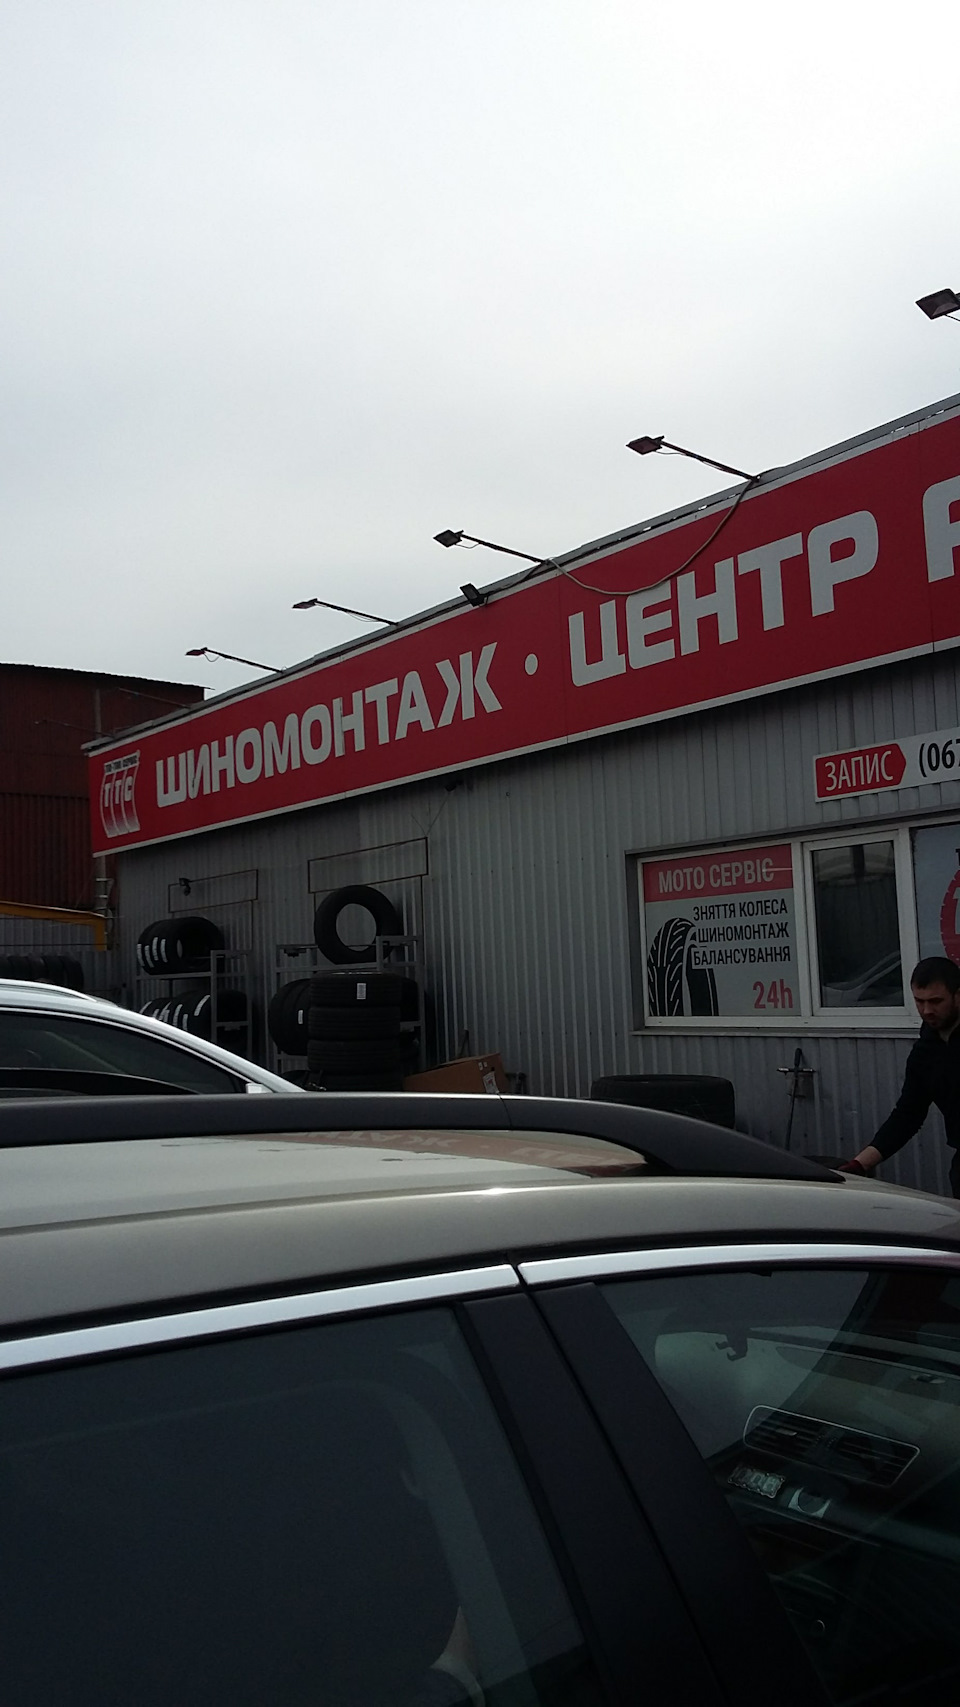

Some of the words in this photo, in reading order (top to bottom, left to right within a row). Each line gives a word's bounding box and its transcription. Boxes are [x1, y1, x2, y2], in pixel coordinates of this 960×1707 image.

[155, 642, 503, 808] ШИНОМОНТАЖ
[568, 510, 879, 687] ЦЕНТР
[824, 750, 894, 792] ЗАПИС
[658, 866, 706, 893] МОТО
[709, 857, 775, 887] СЕРВІС
[693, 902, 737, 921] ЗНЯТТЯ
[739, 898, 788, 918] КОЛЕСА
[697, 922, 790, 943] ШИНОМОНТАЖ
[692, 944, 791, 966] БАЛАНСУВАННЯ
[752, 978, 794, 1009] 24h
